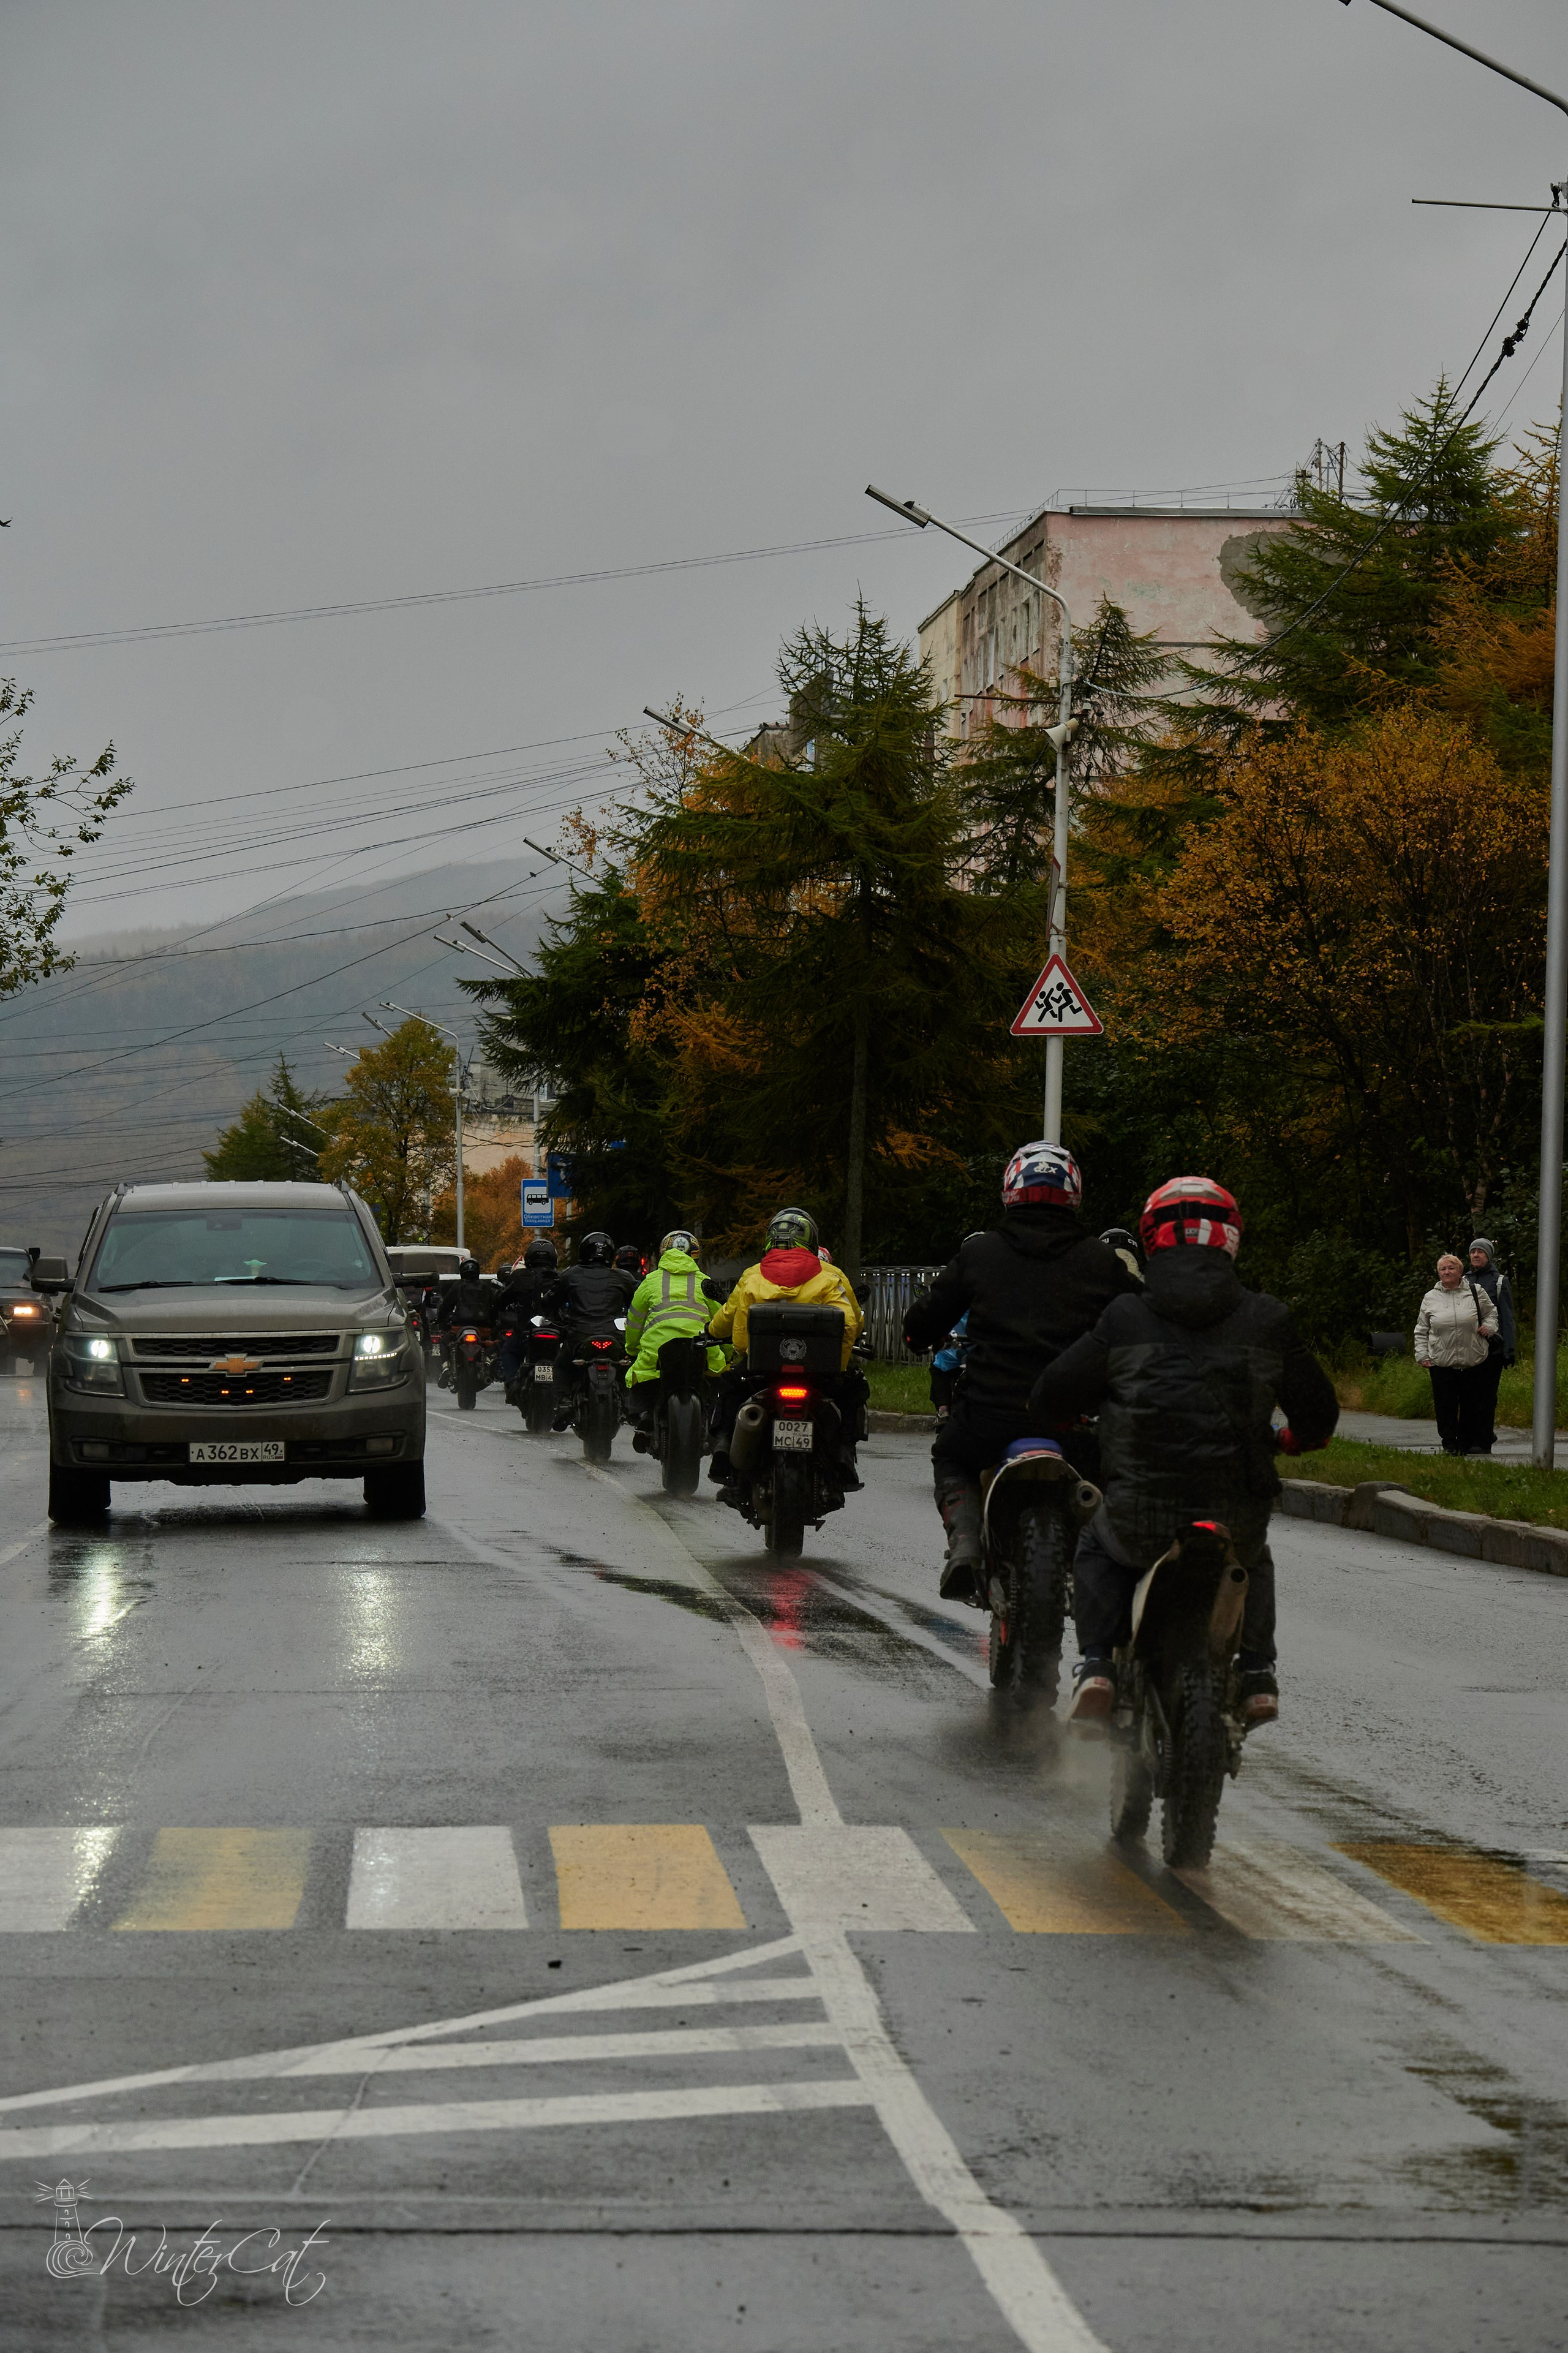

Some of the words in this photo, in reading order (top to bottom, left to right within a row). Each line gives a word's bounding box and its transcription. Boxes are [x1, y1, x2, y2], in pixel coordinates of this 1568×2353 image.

[779, 1421, 808, 1432] 0027
[796, 1438, 810, 1447] 49
[264, 1443, 279, 1455] 49
